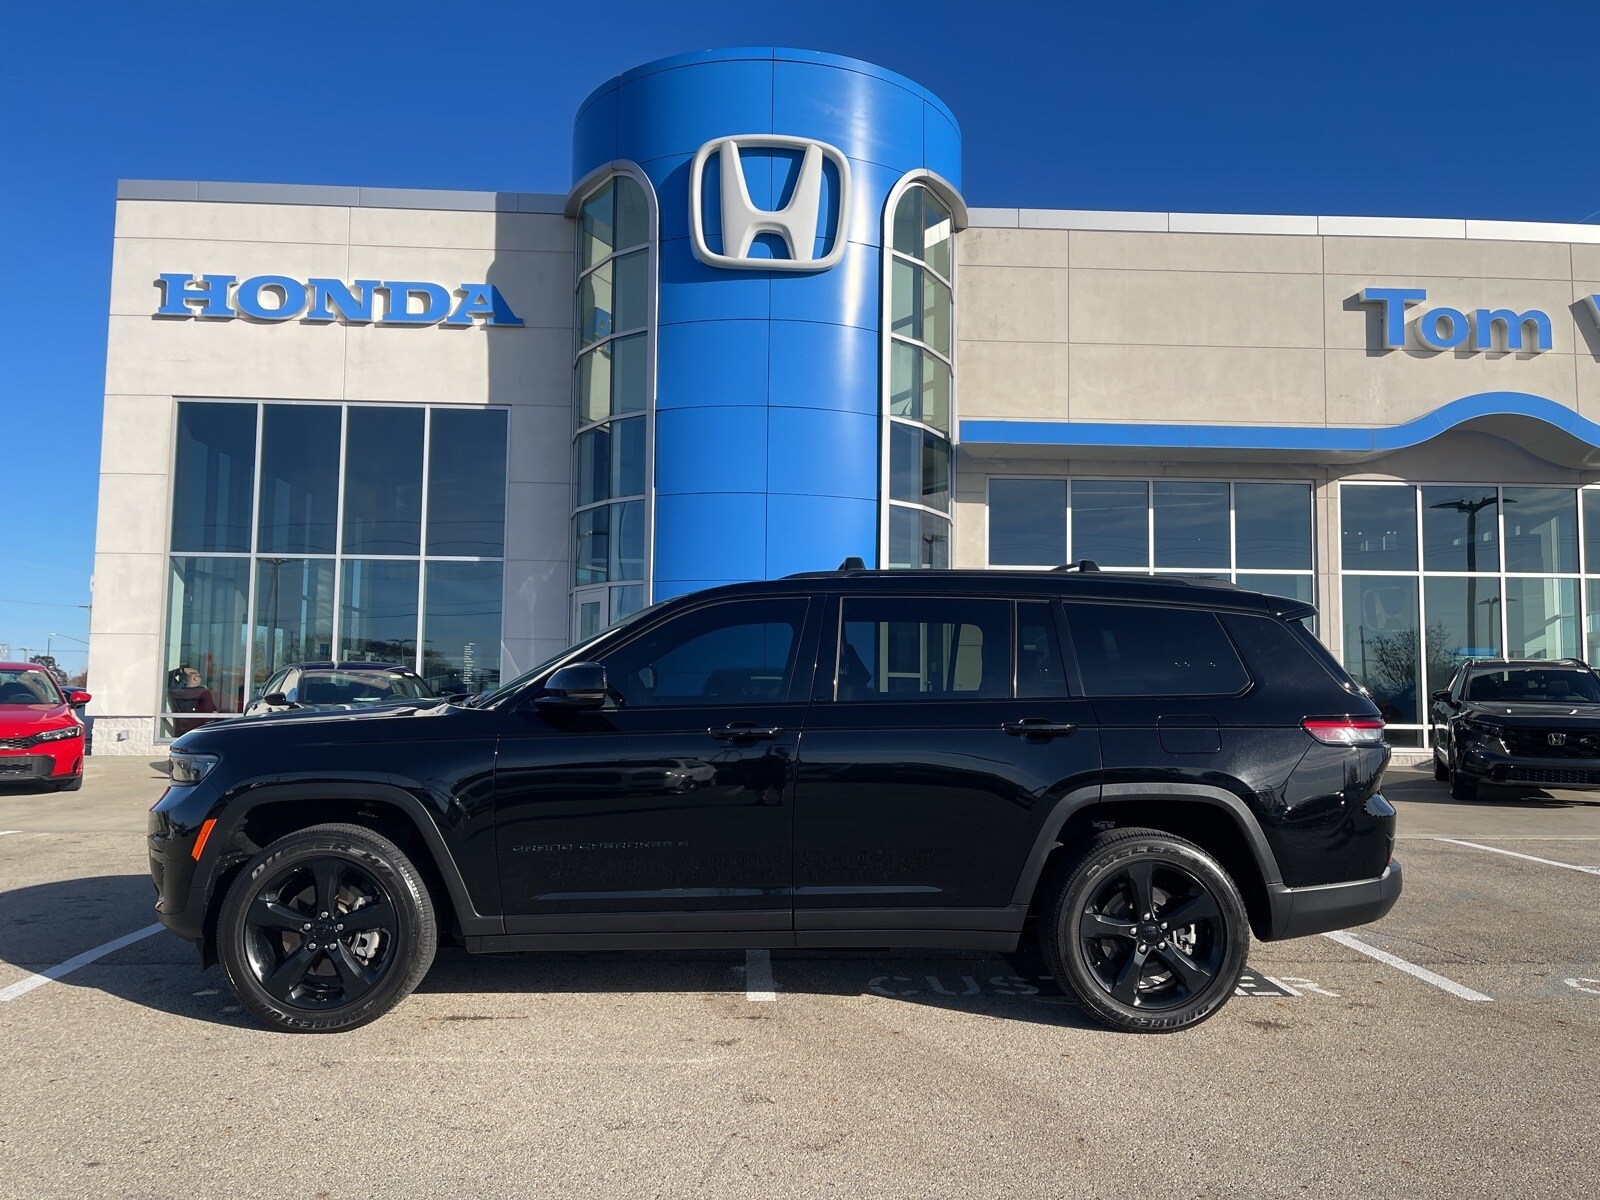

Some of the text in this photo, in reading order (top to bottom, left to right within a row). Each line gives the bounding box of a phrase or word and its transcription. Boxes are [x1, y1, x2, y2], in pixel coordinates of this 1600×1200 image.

[156, 272, 525, 327] HONDA
[1358, 287, 1553, 351] Tom
[867, 974, 1341, 997] CUSER
